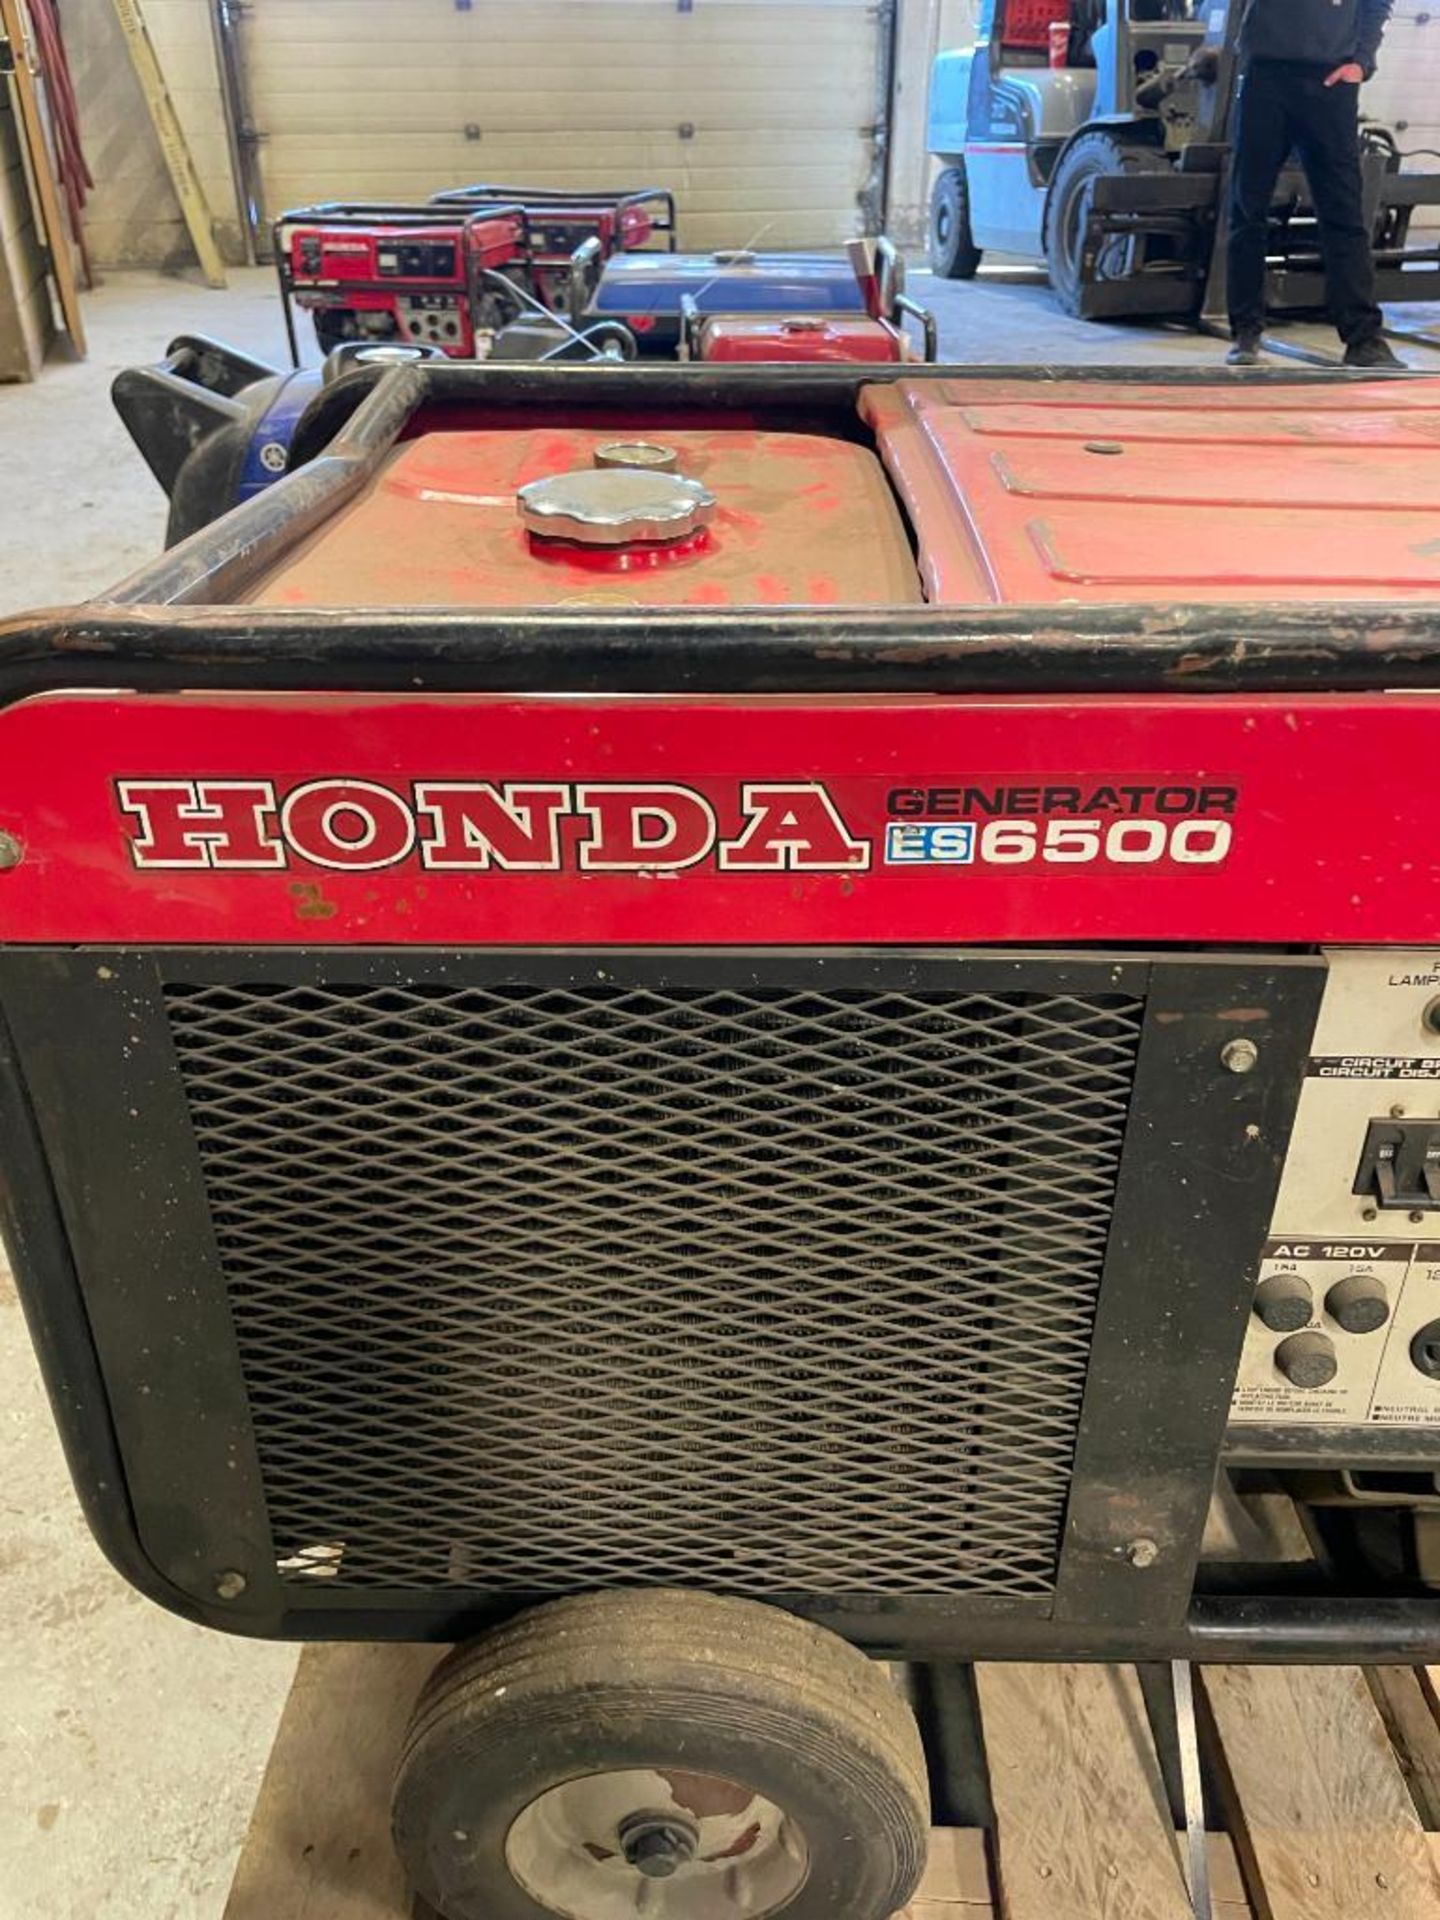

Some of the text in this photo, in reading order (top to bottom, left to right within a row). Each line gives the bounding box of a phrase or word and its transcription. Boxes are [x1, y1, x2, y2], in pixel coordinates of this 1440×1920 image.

[886, 786, 1237, 816] GENERATOR
[114, 778, 872, 873] HONDA
[887, 819, 1234, 864] ES 6500
[1388, 974, 1440, 986] LAMP
[1341, 1058, 1416, 1069] CIRCUIT
[1319, 1066, 1394, 1077] CIRCUIT
[1273, 1245, 1386, 1258] AC 120V
